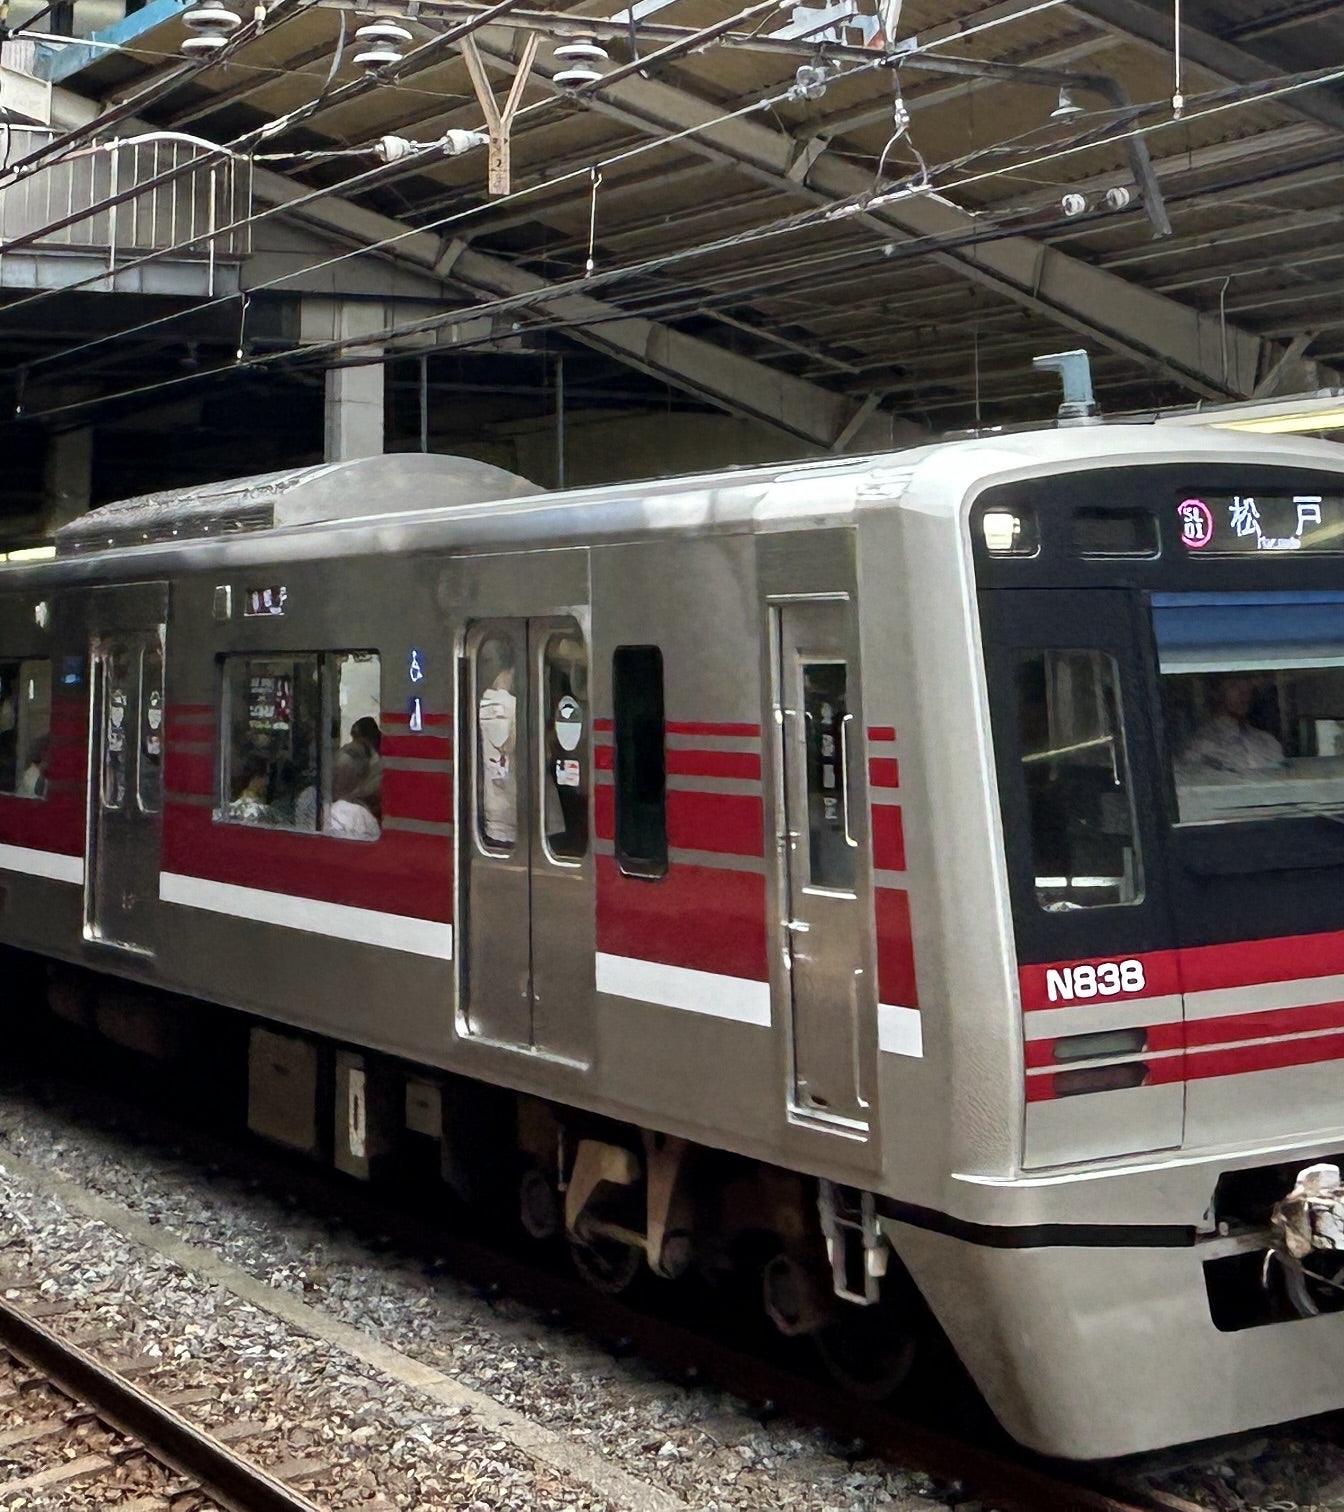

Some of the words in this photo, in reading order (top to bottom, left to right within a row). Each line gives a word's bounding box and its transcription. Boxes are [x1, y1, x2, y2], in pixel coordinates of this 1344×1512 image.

[1183, 506, 1204, 522] SL
[1229, 496, 1322, 537] 松戸
[1184, 522, 1205, 539] 01
[1046, 959, 1146, 1002] N838
